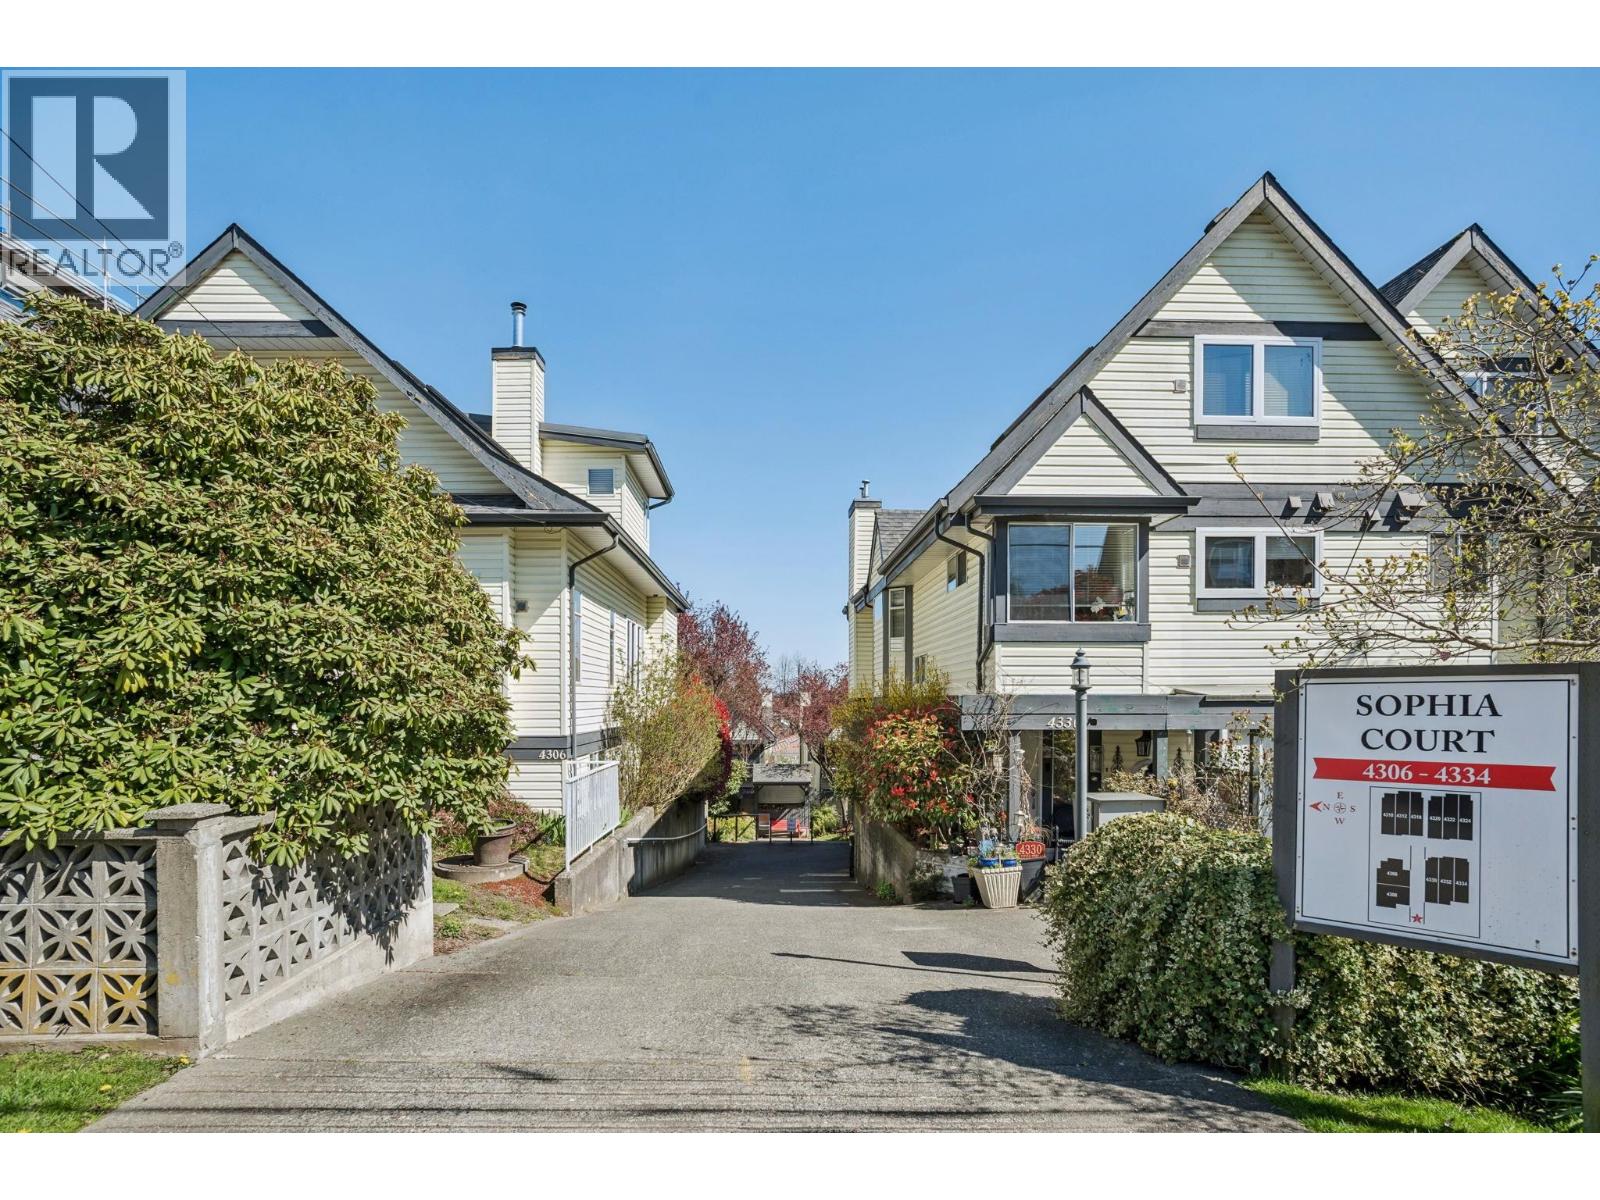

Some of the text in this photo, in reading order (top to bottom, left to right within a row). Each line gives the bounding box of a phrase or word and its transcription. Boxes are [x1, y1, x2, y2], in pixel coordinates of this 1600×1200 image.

[1356, 693, 1502, 717] SOPHIA
[1361, 728, 1495, 753] COURT
[538, 749, 567, 760] 4306
[1362, 763, 1413, 780] 4306
[1433, 766, 1492, 785] 4334
[1336, 791, 1345, 800] E
[1322, 802, 1331, 811] N
[1350, 804, 1356, 813] S
[1334, 816, 1345, 825] W
[1019, 844, 1043, 855] 4330
